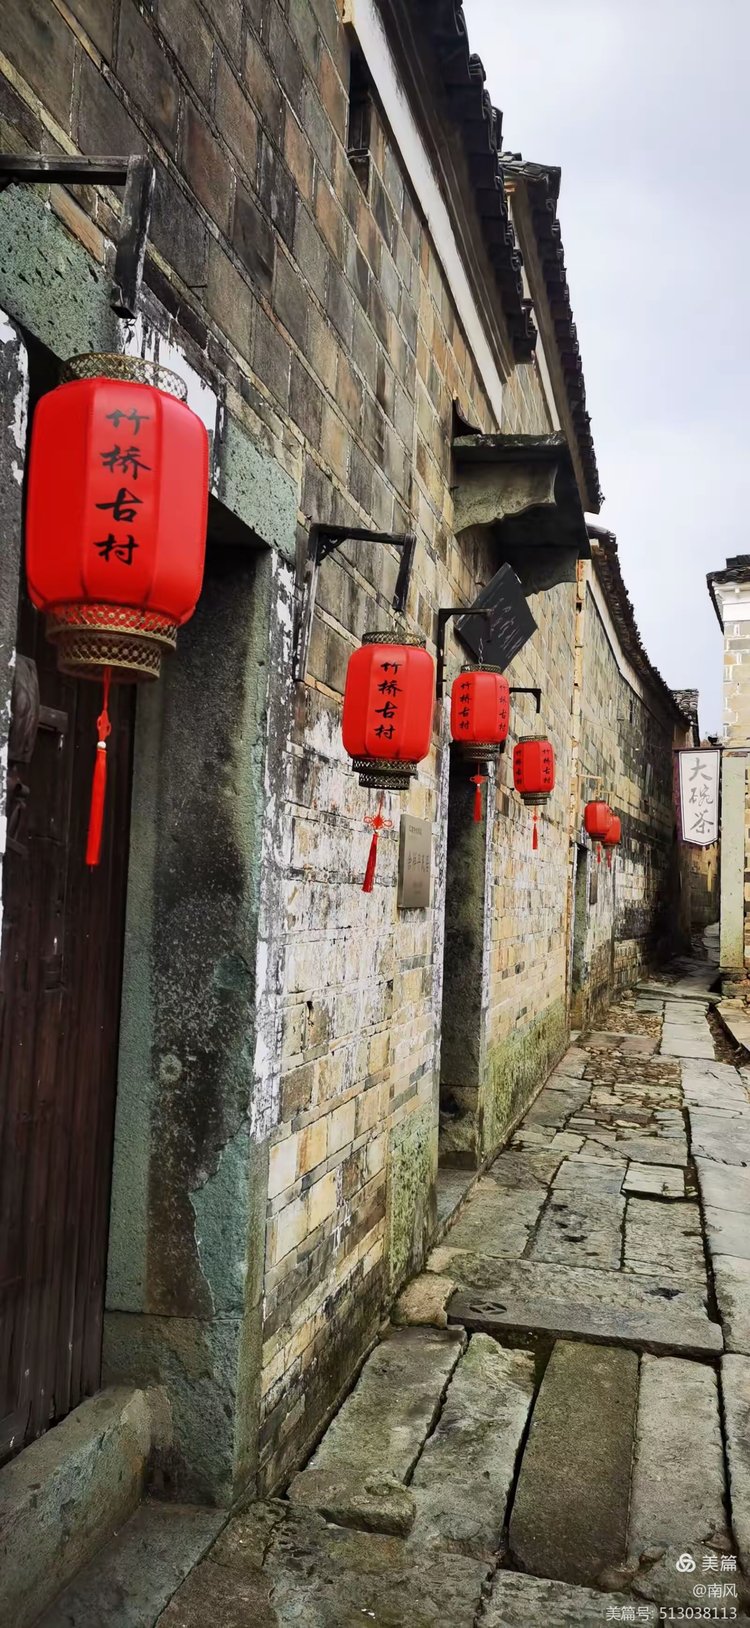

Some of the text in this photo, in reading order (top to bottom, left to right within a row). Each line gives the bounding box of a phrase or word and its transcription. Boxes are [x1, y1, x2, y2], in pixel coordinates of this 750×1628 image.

[93, 407, 152, 566] 竹桥古村
[373, 660, 403, 741] 竹桥古村
[688, 757, 715, 835] 大碗茶
